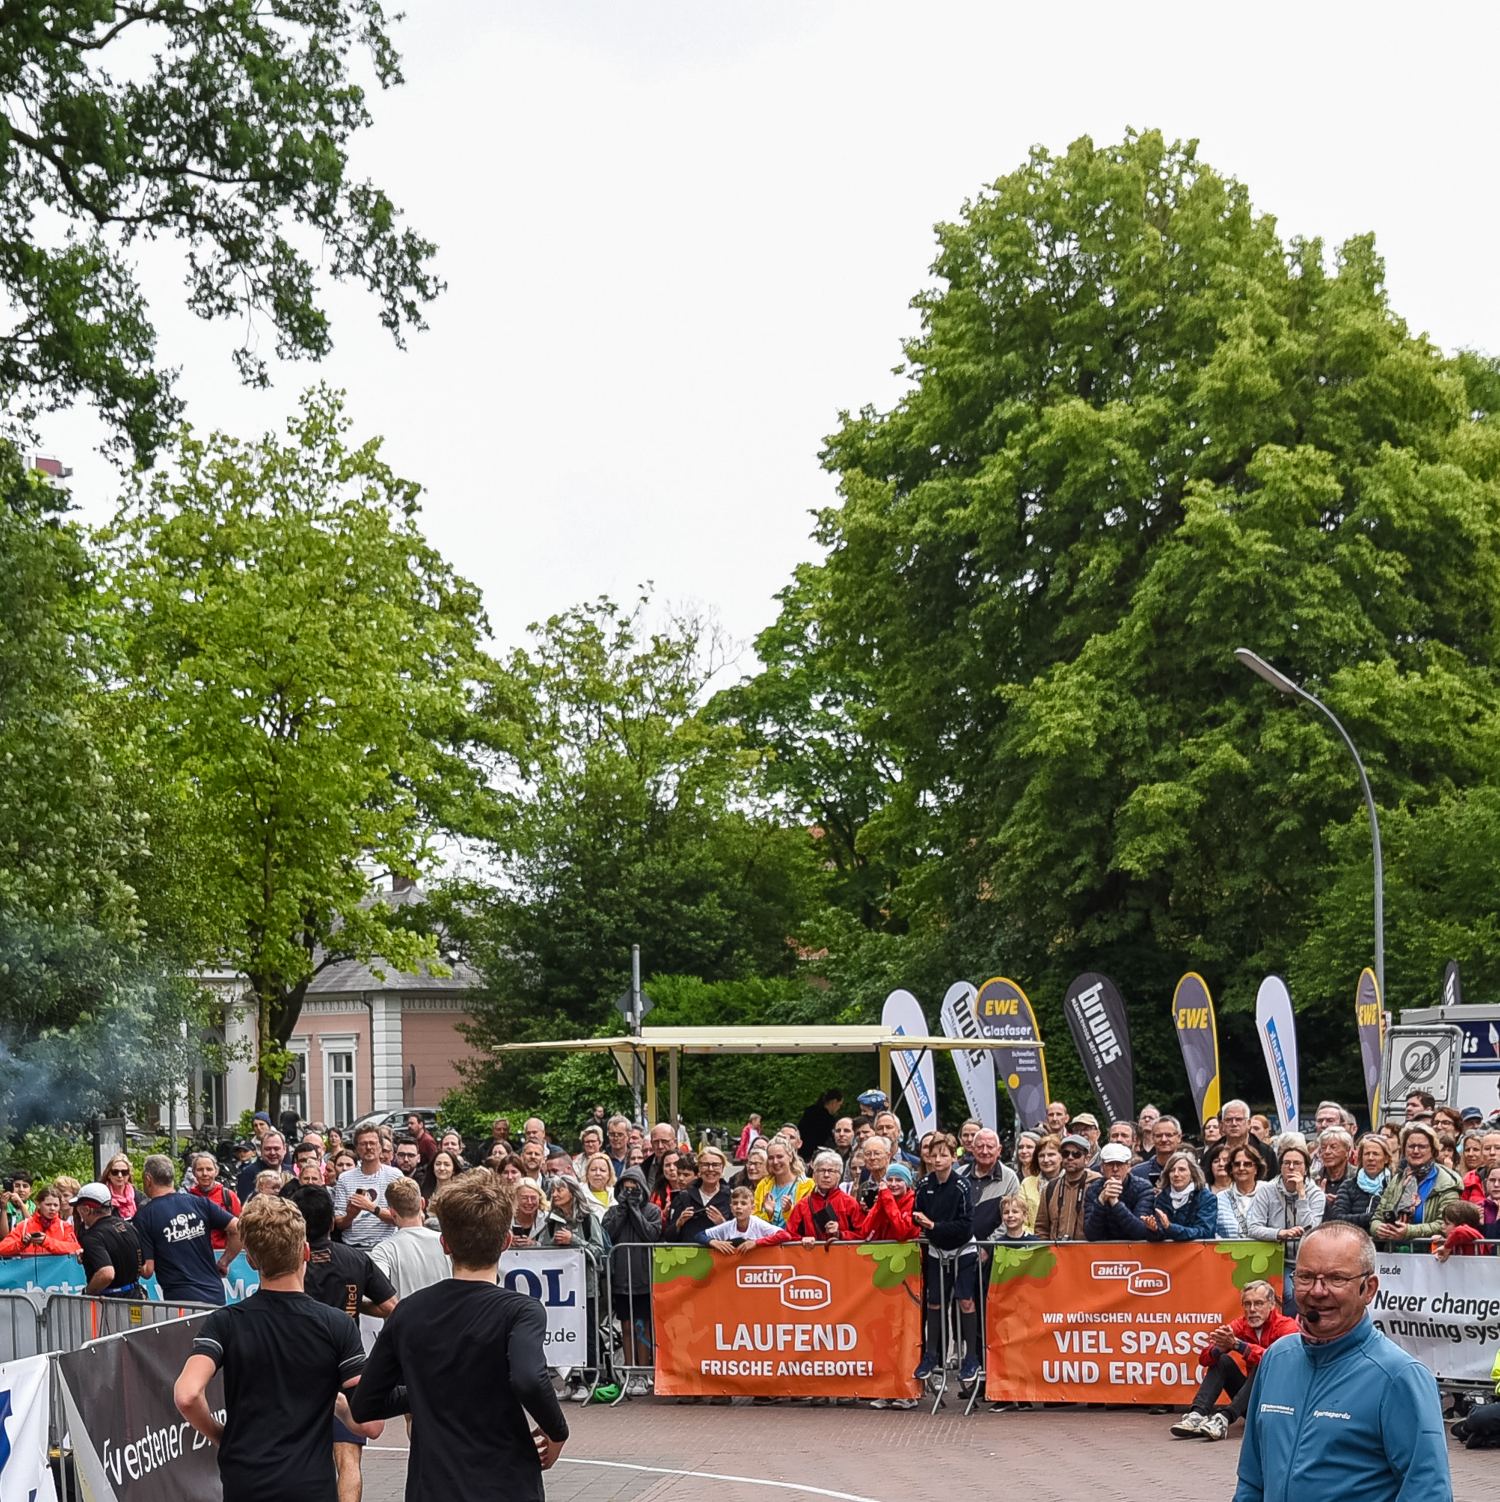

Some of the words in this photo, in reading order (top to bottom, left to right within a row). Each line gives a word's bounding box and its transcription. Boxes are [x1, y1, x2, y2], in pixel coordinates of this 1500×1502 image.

[985, 999, 1019, 1016] EWE
[1078, 982, 1122, 1065] bruns
[1177, 1007, 1208, 1029] EWE
[983, 1024, 1032, 1036] Glasfaser
[1452, 1031, 1478, 1053] is
[1410, 1052, 1432, 1071] 20
[1094, 1075, 1104, 1093] WAS
[1102, 1094, 1117, 1122] MÄNNE
[163, 1219, 205, 1243] Herbart
[744, 1269, 782, 1283] aktiv
[1097, 1264, 1130, 1276] aktiv
[1380, 1264, 1401, 1276] ise.de
[504, 1269, 575, 1307] OL
[1134, 1276, 1163, 1288] irma
[789, 1285, 822, 1300] irma
[1374, 1290, 1434, 1313] Never
[1438, 1292, 1500, 1321] change
[1042, 1313, 1063, 1323] WIR
[1067, 1311, 1132, 1323] WÜNSCHEN
[1136, 1313, 1171, 1323] ALLEN
[1175, 1313, 1222, 1324] AKTIVEN
[544, 1328, 576, 1345] g.de
[715, 1323, 857, 1351] LAUFEND
[1373, 1320, 1386, 1335] a
[1389, 1318, 1461, 1344] running
[1053, 1331, 1114, 1354] VIEL
[1121, 1330, 1211, 1355] SPASS
[701, 1360, 773, 1376] FRISCHE
[776, 1361, 873, 1376] ANGEBOTE!
[1042, 1361, 1100, 1384] UND
